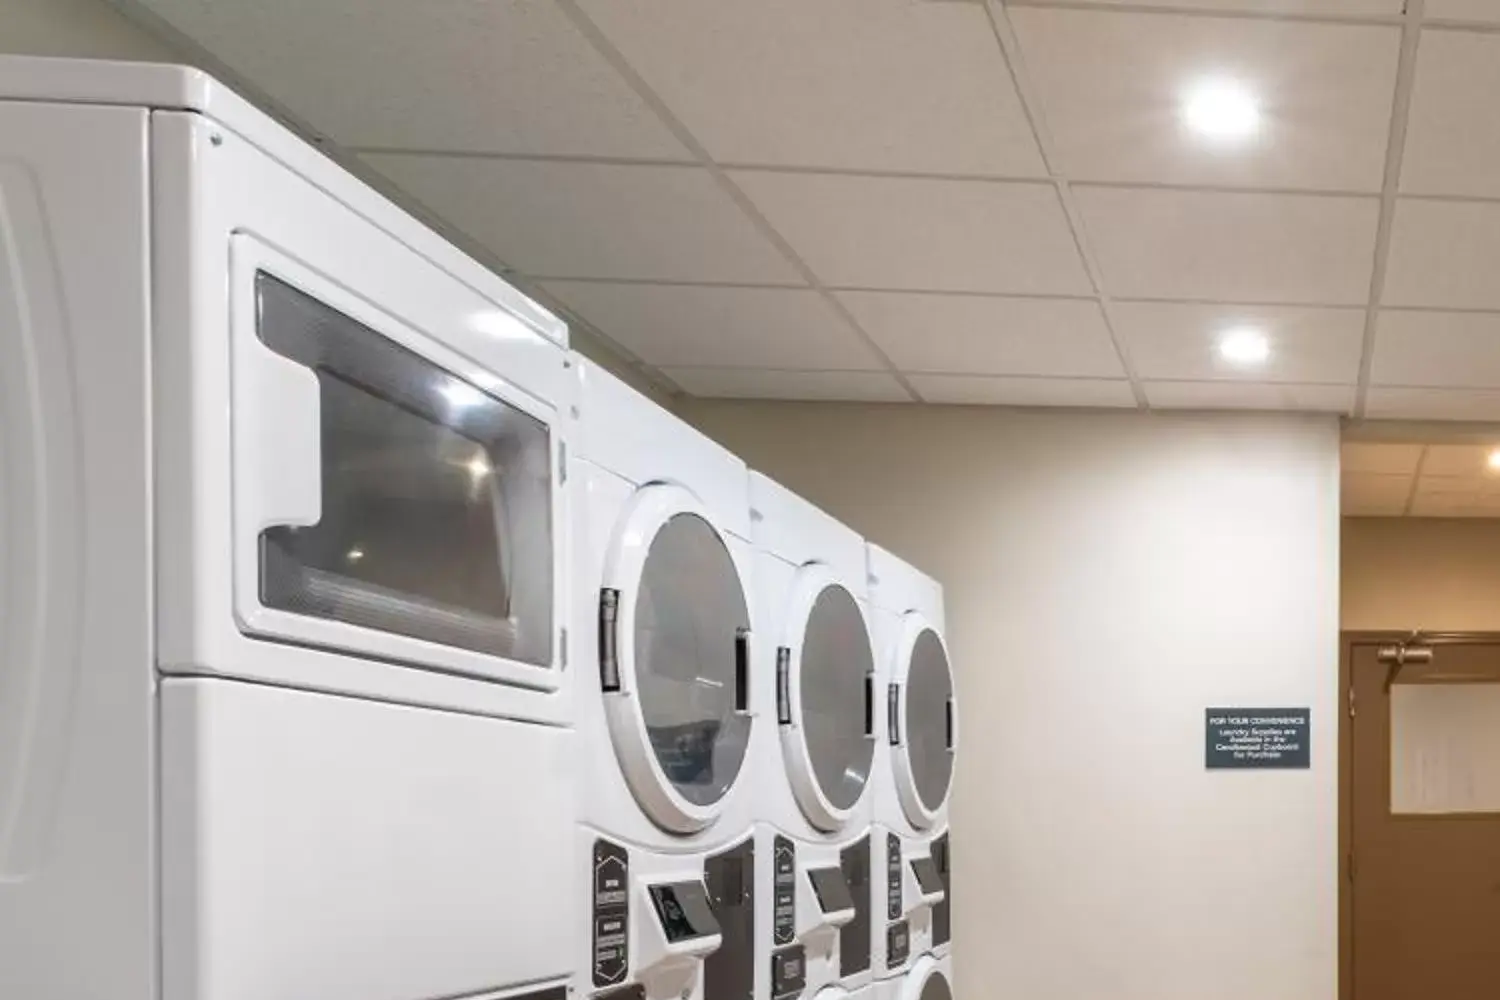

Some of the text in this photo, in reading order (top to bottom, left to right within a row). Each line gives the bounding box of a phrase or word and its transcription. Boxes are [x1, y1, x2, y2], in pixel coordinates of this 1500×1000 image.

[1210, 717, 1305, 725] FOR YOUR CONVENIENCE
